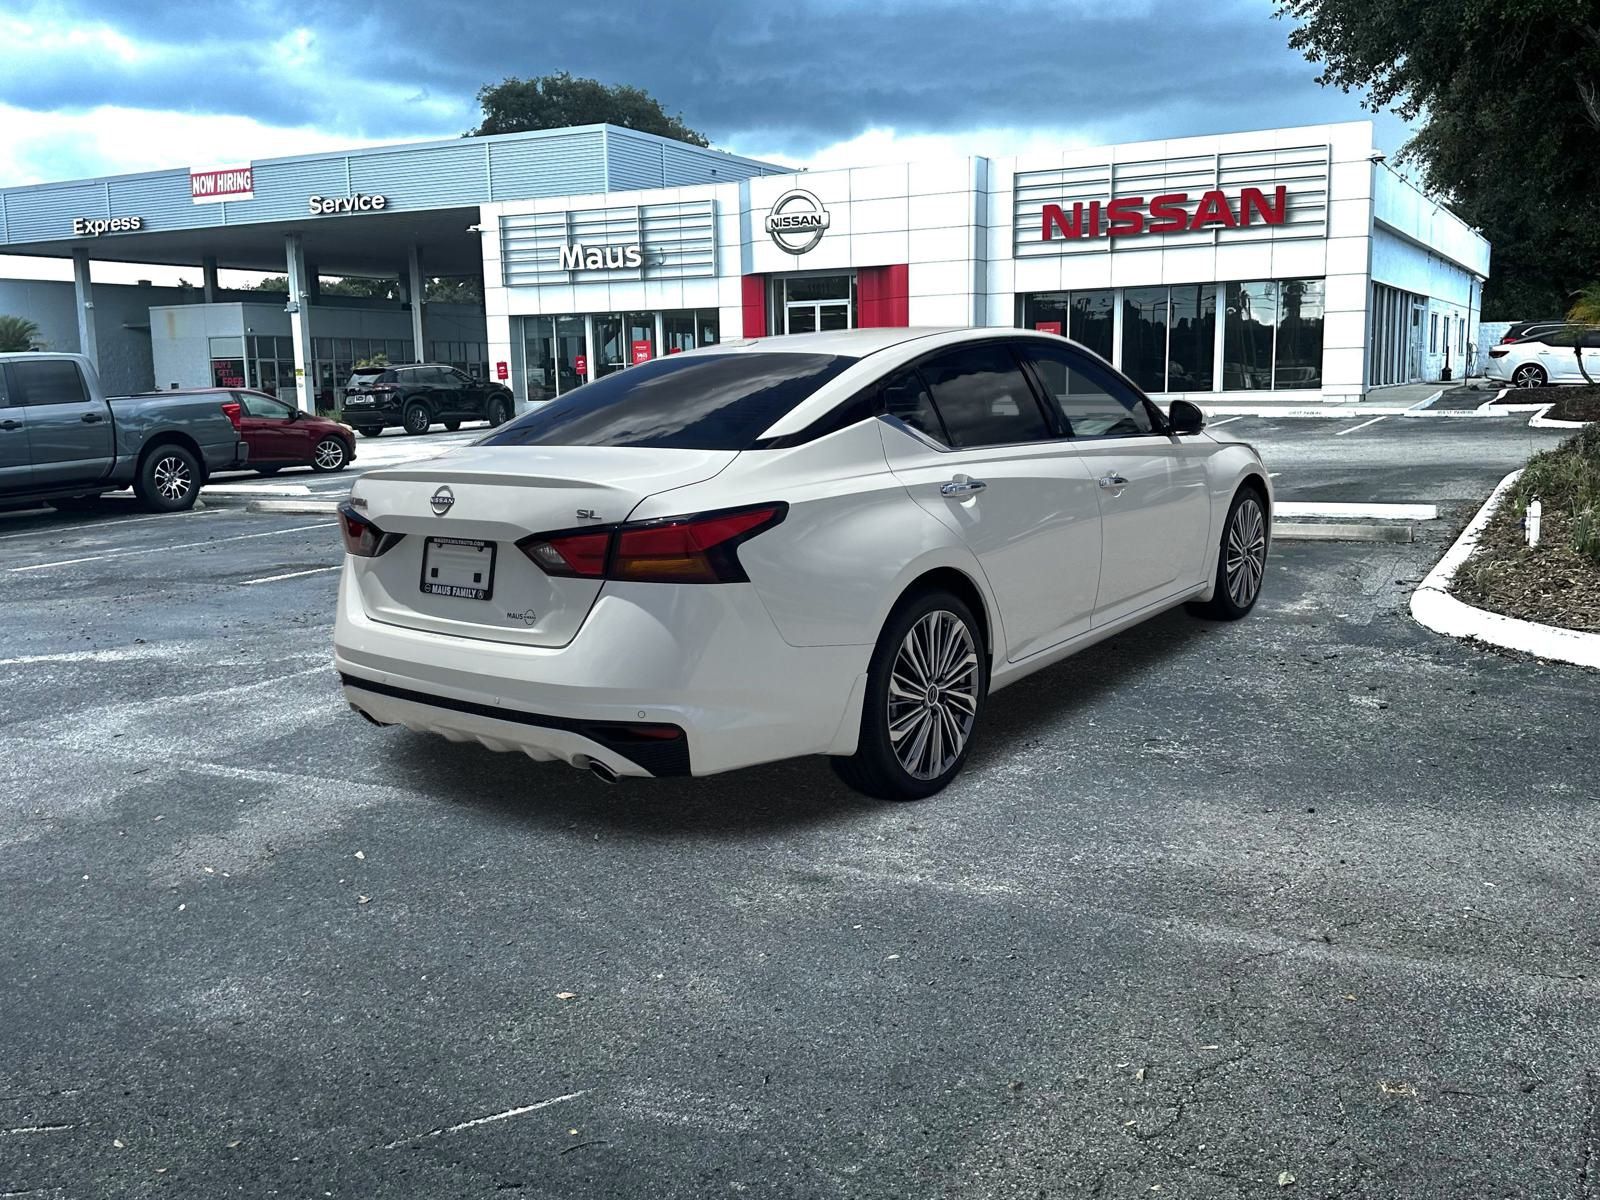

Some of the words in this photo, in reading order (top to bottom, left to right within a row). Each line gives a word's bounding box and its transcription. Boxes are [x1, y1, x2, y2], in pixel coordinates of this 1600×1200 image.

[192, 173, 215, 195] NOW
[217, 170, 251, 192] HIRING
[308, 193, 386, 215] Service
[1042, 185, 1287, 241] NISSAN
[72, 214, 142, 237] Express
[770, 214, 822, 229] NISSAN
[559, 243, 643, 270] Maus
[222, 377, 244, 387] FREE
[576, 509, 602, 520] SL
[431, 584, 451, 596] MAUS
[452, 587, 477, 599] FAMILY
[506, 612, 524, 620] MAUS
